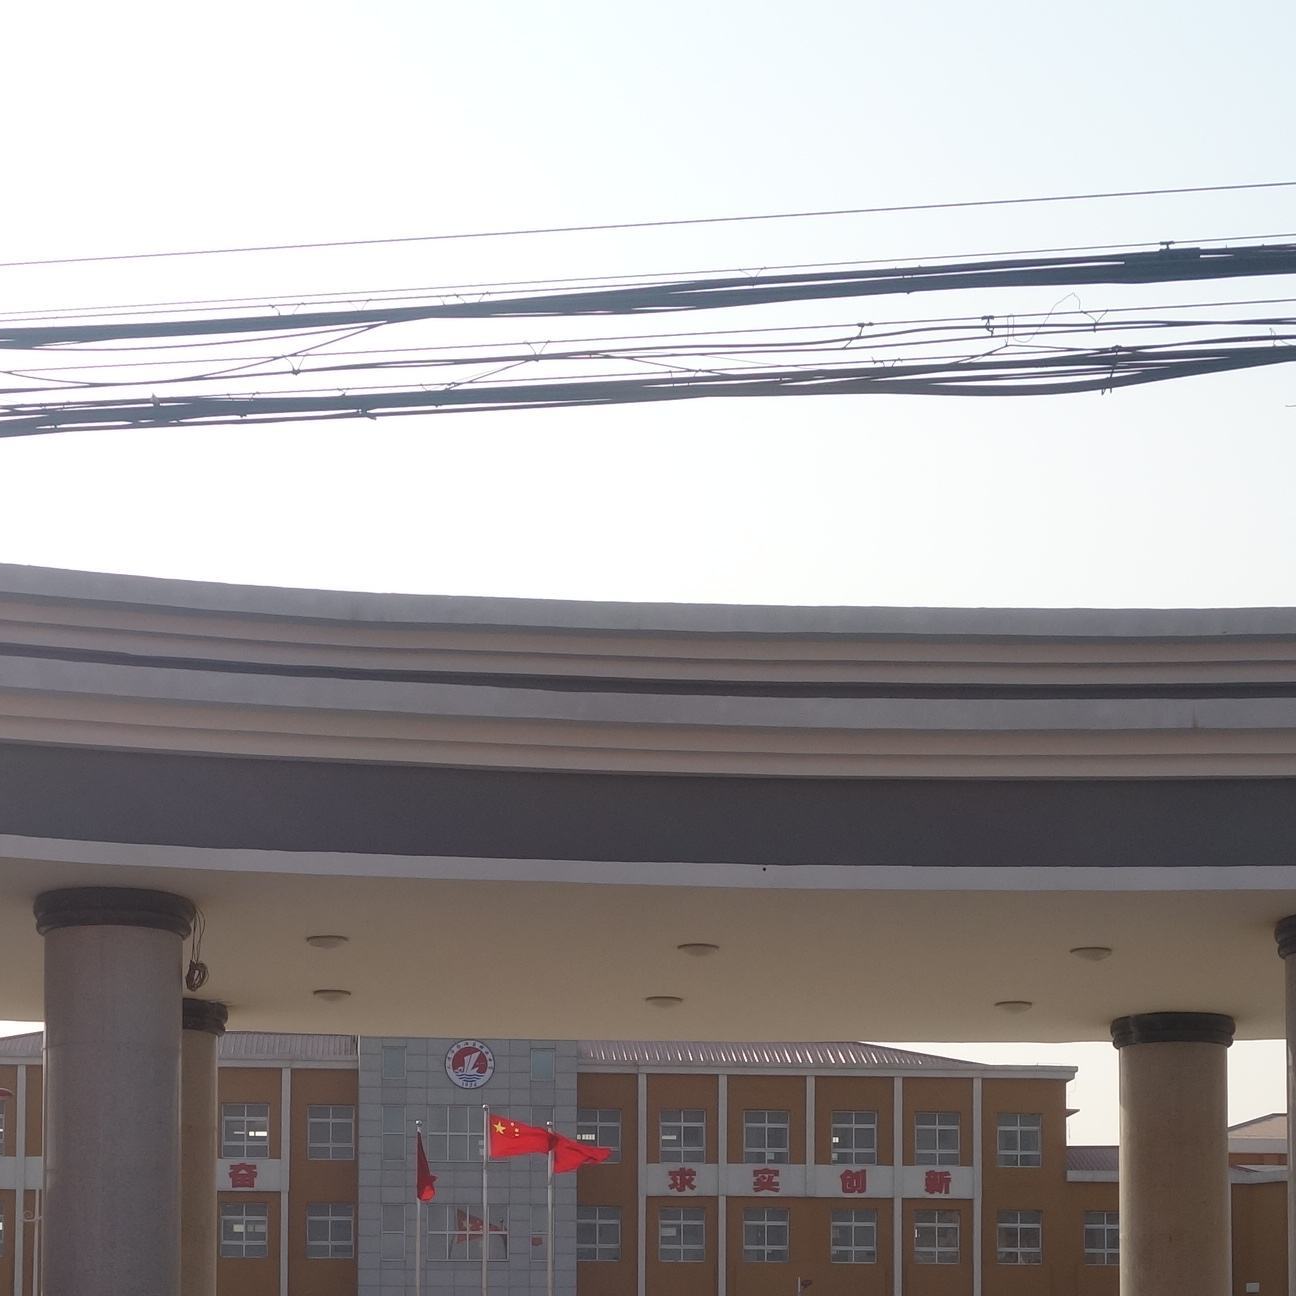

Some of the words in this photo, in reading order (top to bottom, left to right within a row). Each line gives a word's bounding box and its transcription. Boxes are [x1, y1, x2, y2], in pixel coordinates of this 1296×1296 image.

[229, 1163, 257, 1188] 奋
[667, 1167, 952, 1195] 求实创新
